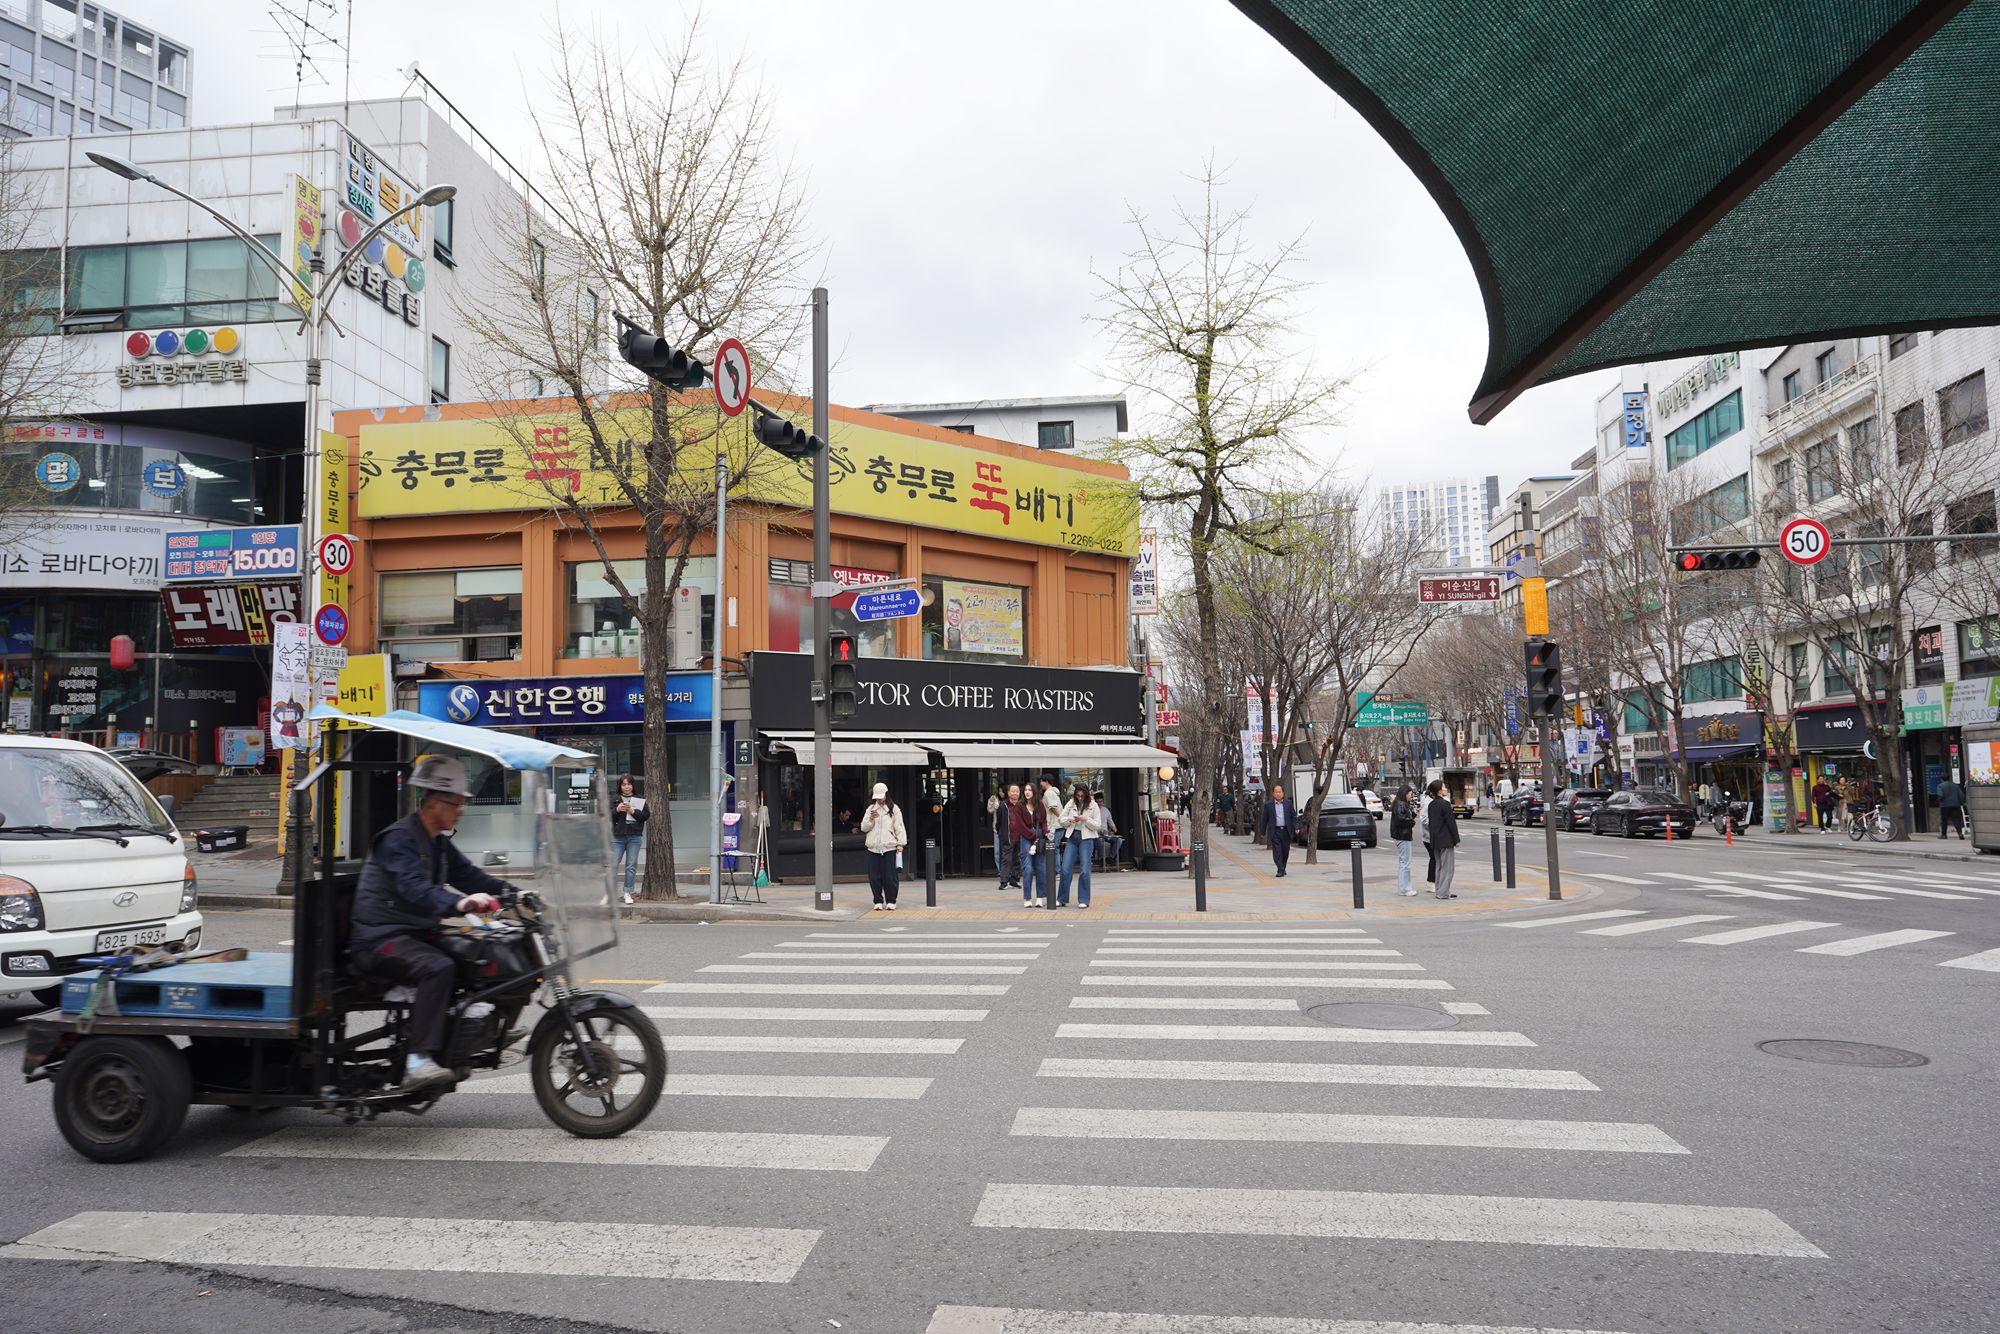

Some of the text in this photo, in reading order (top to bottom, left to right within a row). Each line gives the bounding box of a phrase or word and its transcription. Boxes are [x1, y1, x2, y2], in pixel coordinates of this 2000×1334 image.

[350, 140, 376, 173] 대형
[349, 166, 376, 196] 칼라
[348, 186, 376, 218] 청사진
[411, 265, 424, 281] 2F
[299, 292, 313, 306] 2F
[344, 253, 421, 328] 명보클럽
[115, 358, 249, 388] 명보당구클럽
[1657, 349, 1741, 418] 이비인후과 안과
[1626, 396, 1645, 446] 모정기
[153, 467, 177, 489] 보
[391, 449, 507, 490] 충무로
[864, 456, 1073, 527] 충무로 뚝배기
[59, 523, 88, 531] 이자까야
[95, 524, 117, 532] 꼬치류
[124, 527, 161, 535] 로바다야끼
[168, 531, 277, 549] 일요일 1인당
[1792, 530, 1819, 552] 50
[169, 551, 182, 560] 오전
[201, 549, 214, 558] 오후
[232, 547, 296, 571] 15.000
[327, 543, 348, 566] 30
[40, 554, 159, 577] 로바다야끼
[168, 561, 192, 576] 대대
[1132, 570, 1155, 582] 솔벤
[1132, 584, 1155, 596] 출력
[1441, 580, 1481, 591] 이순신길
[872, 593, 902, 604] 마른내로
[1448, 592, 1487, 600] SUNSIN-gil
[868, 602, 906, 611] Mareunnae-ro
[1919, 631, 1943, 655] 치과
[341, 686, 373, 702] 배기
[485, 685, 606, 717] 신한은행
[921, 685, 993, 708] COFFEE
[1004, 688, 1094, 711] ROASTERS
[1155, 711, 1179, 725] 부동산
[1403, 711, 1426, 719] 을지로4가
[1906, 709, 1941, 725] 명보치과
[1949, 708, 1998, 723] SHINYOUNG
[1825, 720, 1846, 729] PLNNER
[104, 931, 160, 949] 82모 1593
